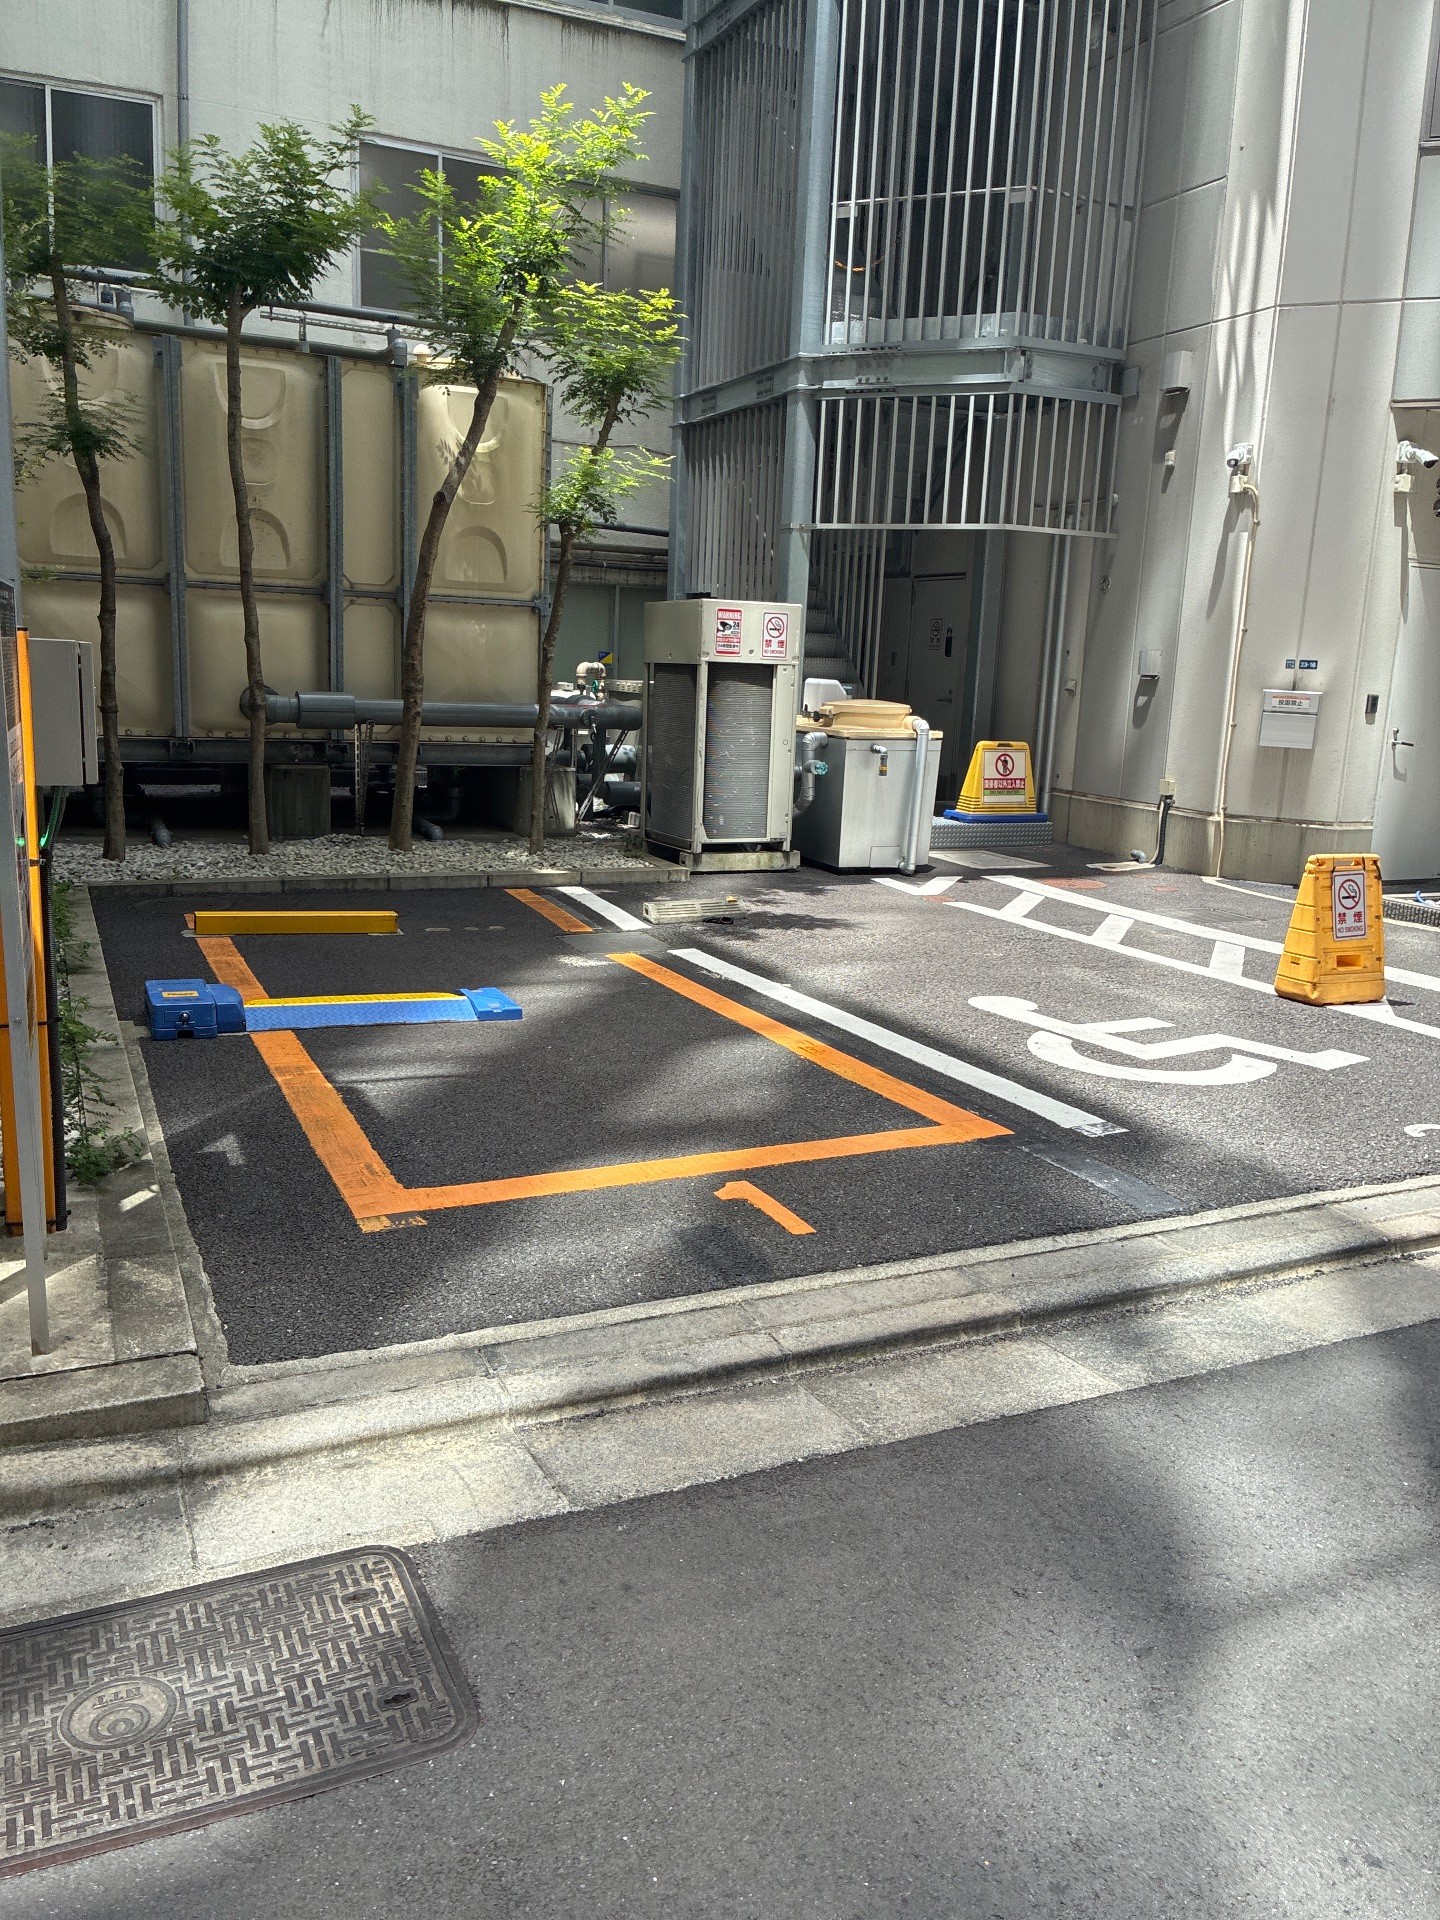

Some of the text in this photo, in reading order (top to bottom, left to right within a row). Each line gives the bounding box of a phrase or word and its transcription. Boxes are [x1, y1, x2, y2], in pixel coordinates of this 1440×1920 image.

[718, 611, 741, 619] WARNING
[765, 639, 785, 648] 禁煙
[1337, 911, 1363, 925] 禁煙
[1345, 925, 1364, 933] SMOKING
[713, 1181, 817, 1236] 1
